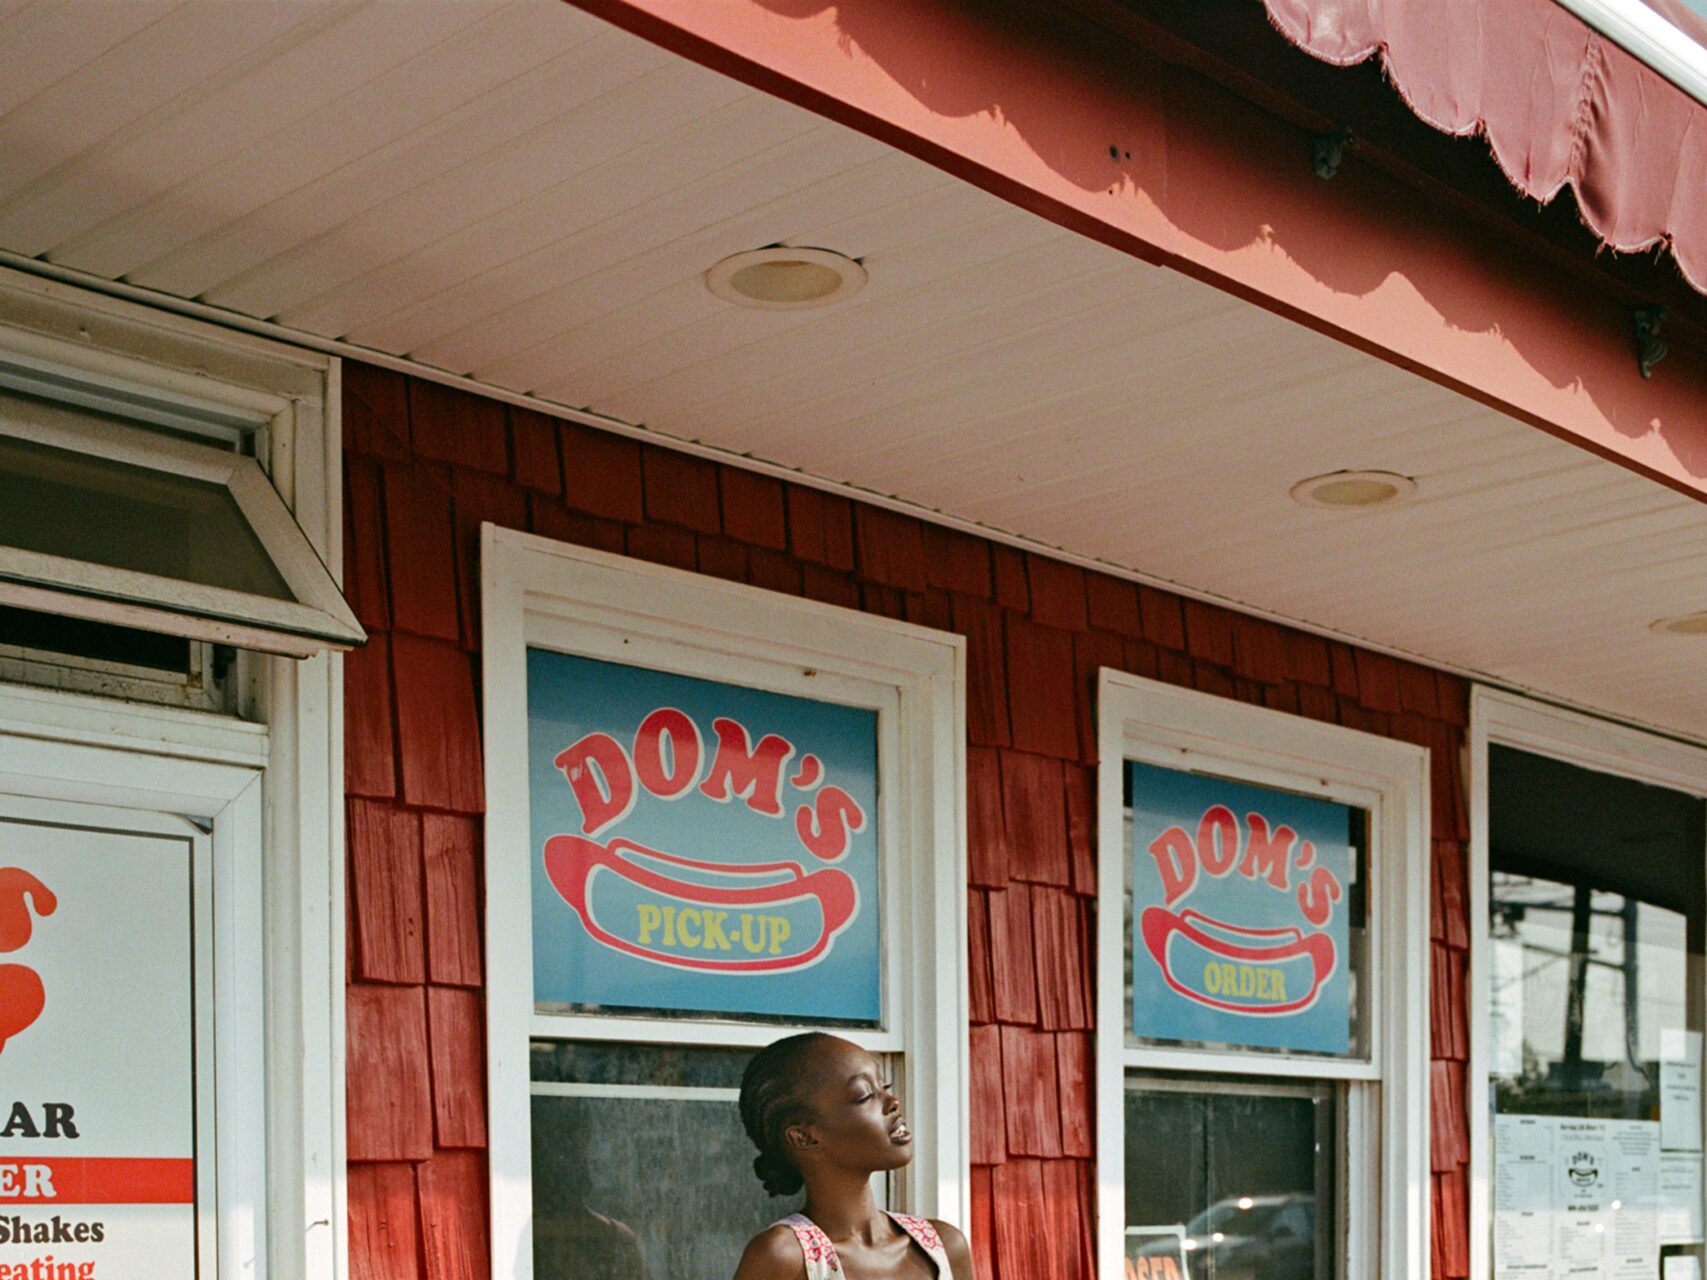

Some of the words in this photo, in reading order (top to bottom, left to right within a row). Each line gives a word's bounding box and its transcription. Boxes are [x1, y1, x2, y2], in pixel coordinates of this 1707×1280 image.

[553, 706, 866, 863] DOM'S
[1148, 804, 1342, 927] DOM'S
[636, 904, 792, 955] PICK-UP
[1203, 961, 1287, 1001] ORDER
